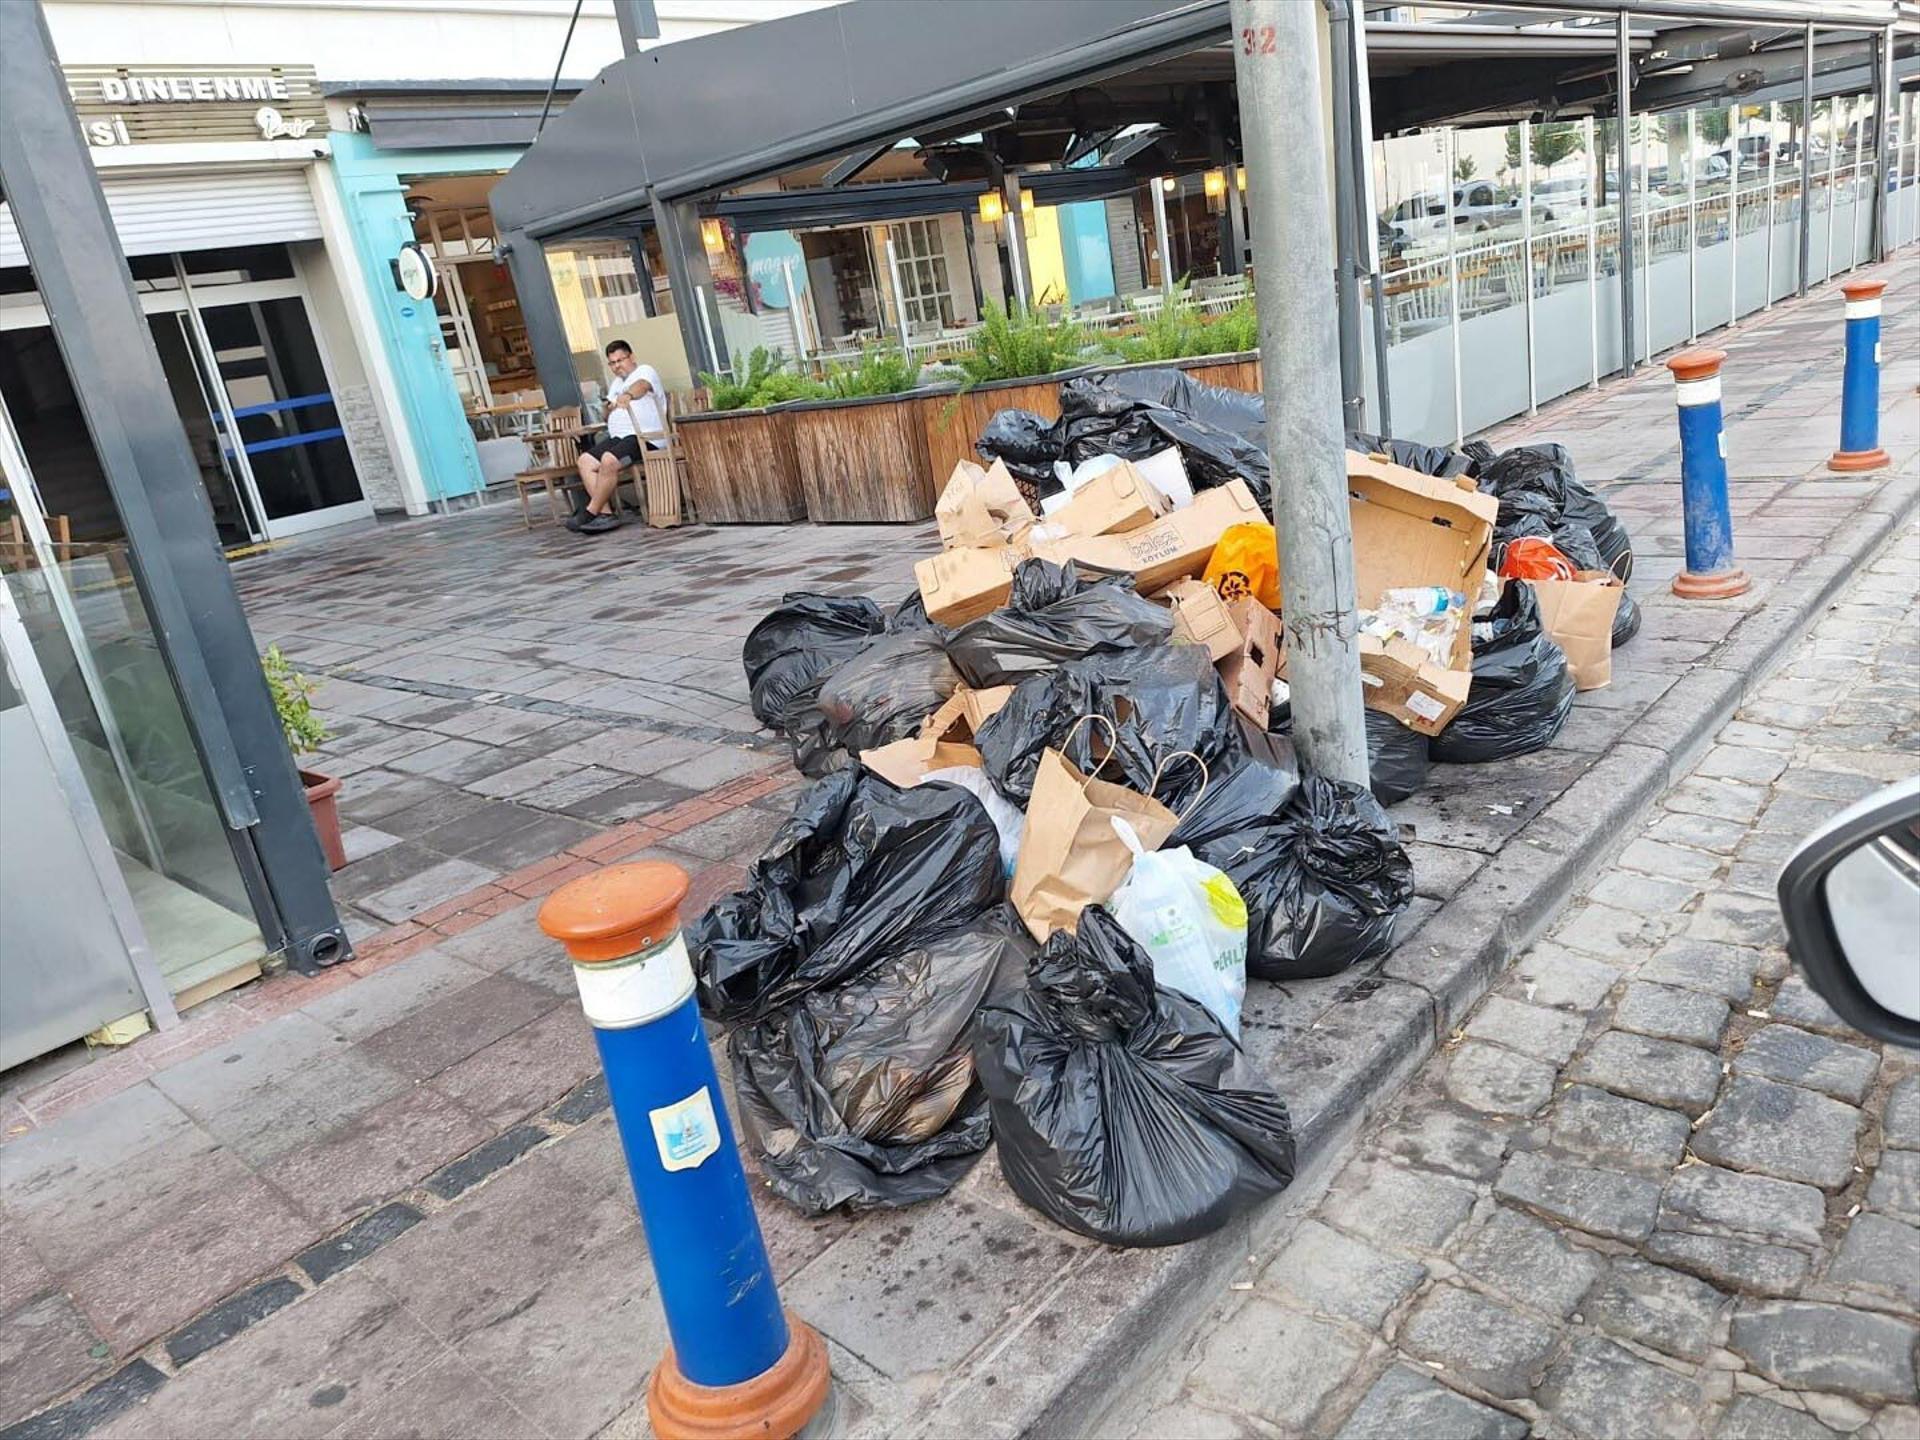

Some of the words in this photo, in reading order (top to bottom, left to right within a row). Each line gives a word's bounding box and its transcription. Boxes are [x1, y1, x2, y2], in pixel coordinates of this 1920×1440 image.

[1242, 27, 1276, 56] 32
[77, 113, 131, 147] Sİ
[1213, 941, 1247, 971] PEHLİ
